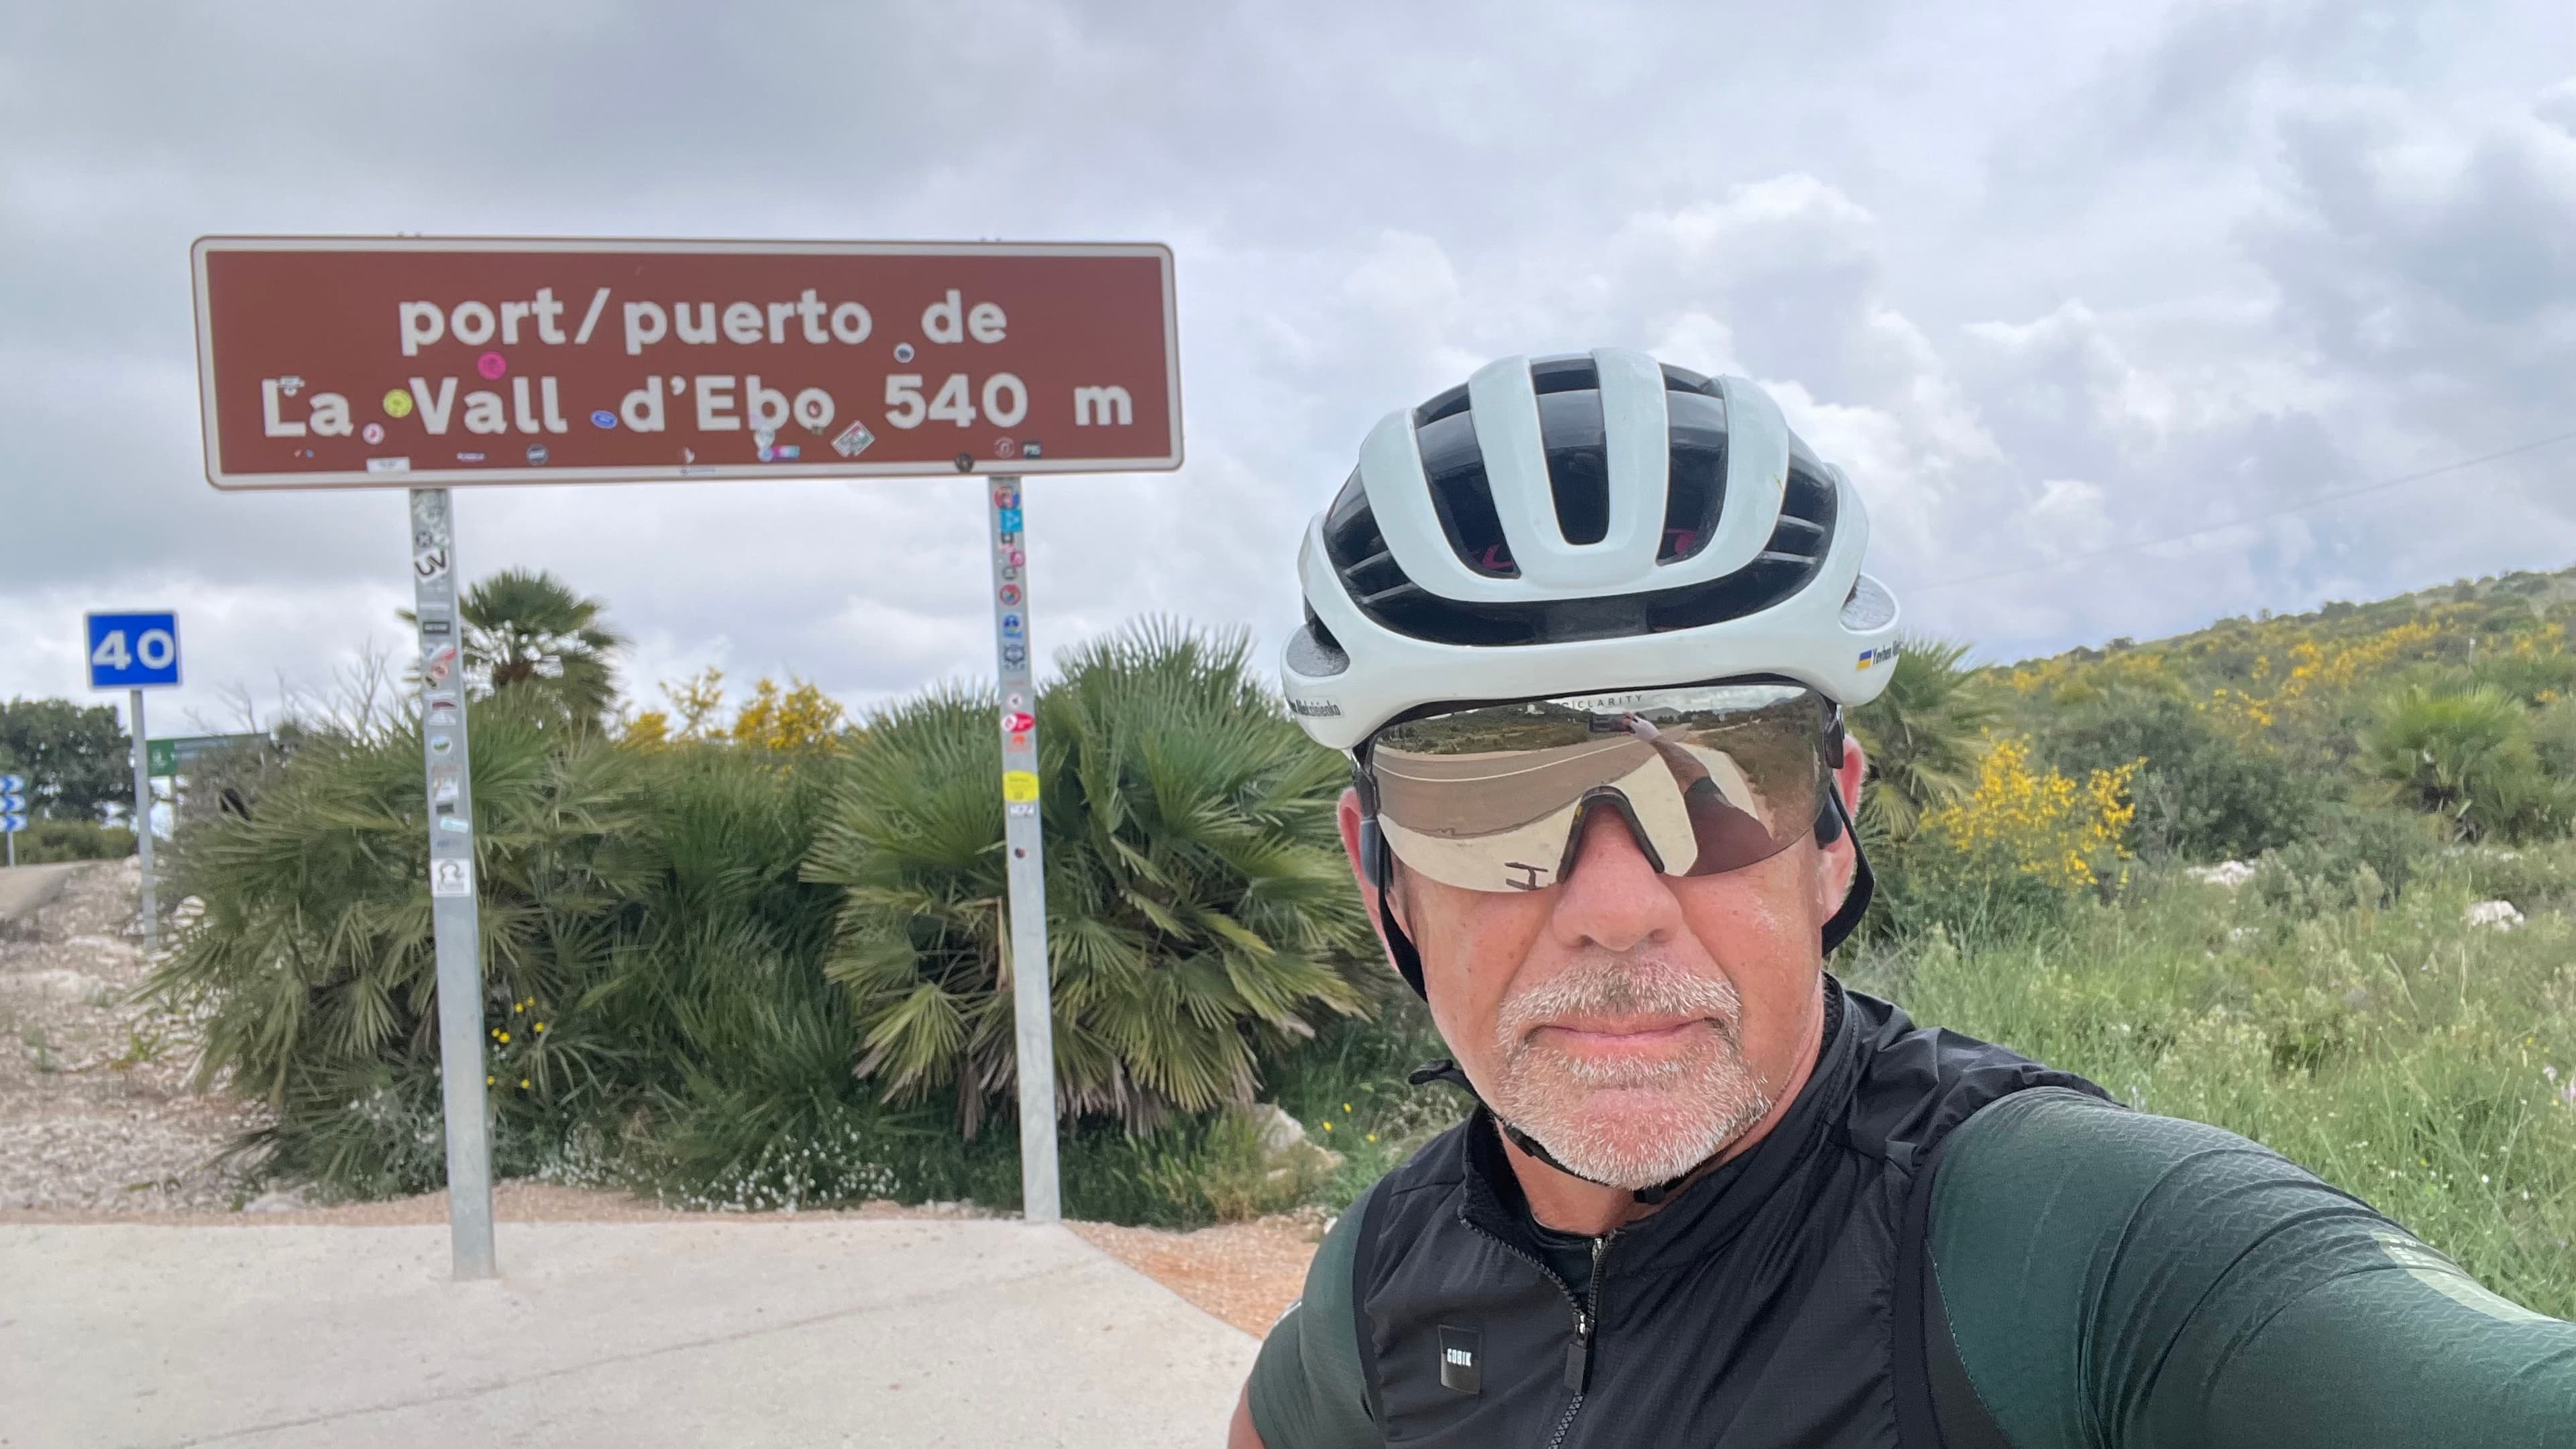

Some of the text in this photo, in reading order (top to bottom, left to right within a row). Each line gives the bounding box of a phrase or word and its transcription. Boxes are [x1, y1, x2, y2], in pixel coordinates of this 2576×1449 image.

[921, 288, 1007, 344] de
[261, 372, 1133, 437] La Vall d'Ebo 540 m
[91, 628, 175, 670] 40
[1577, 694, 1642, 709] CLARITY
[1446, 1348, 1472, 1367] GOBIK
